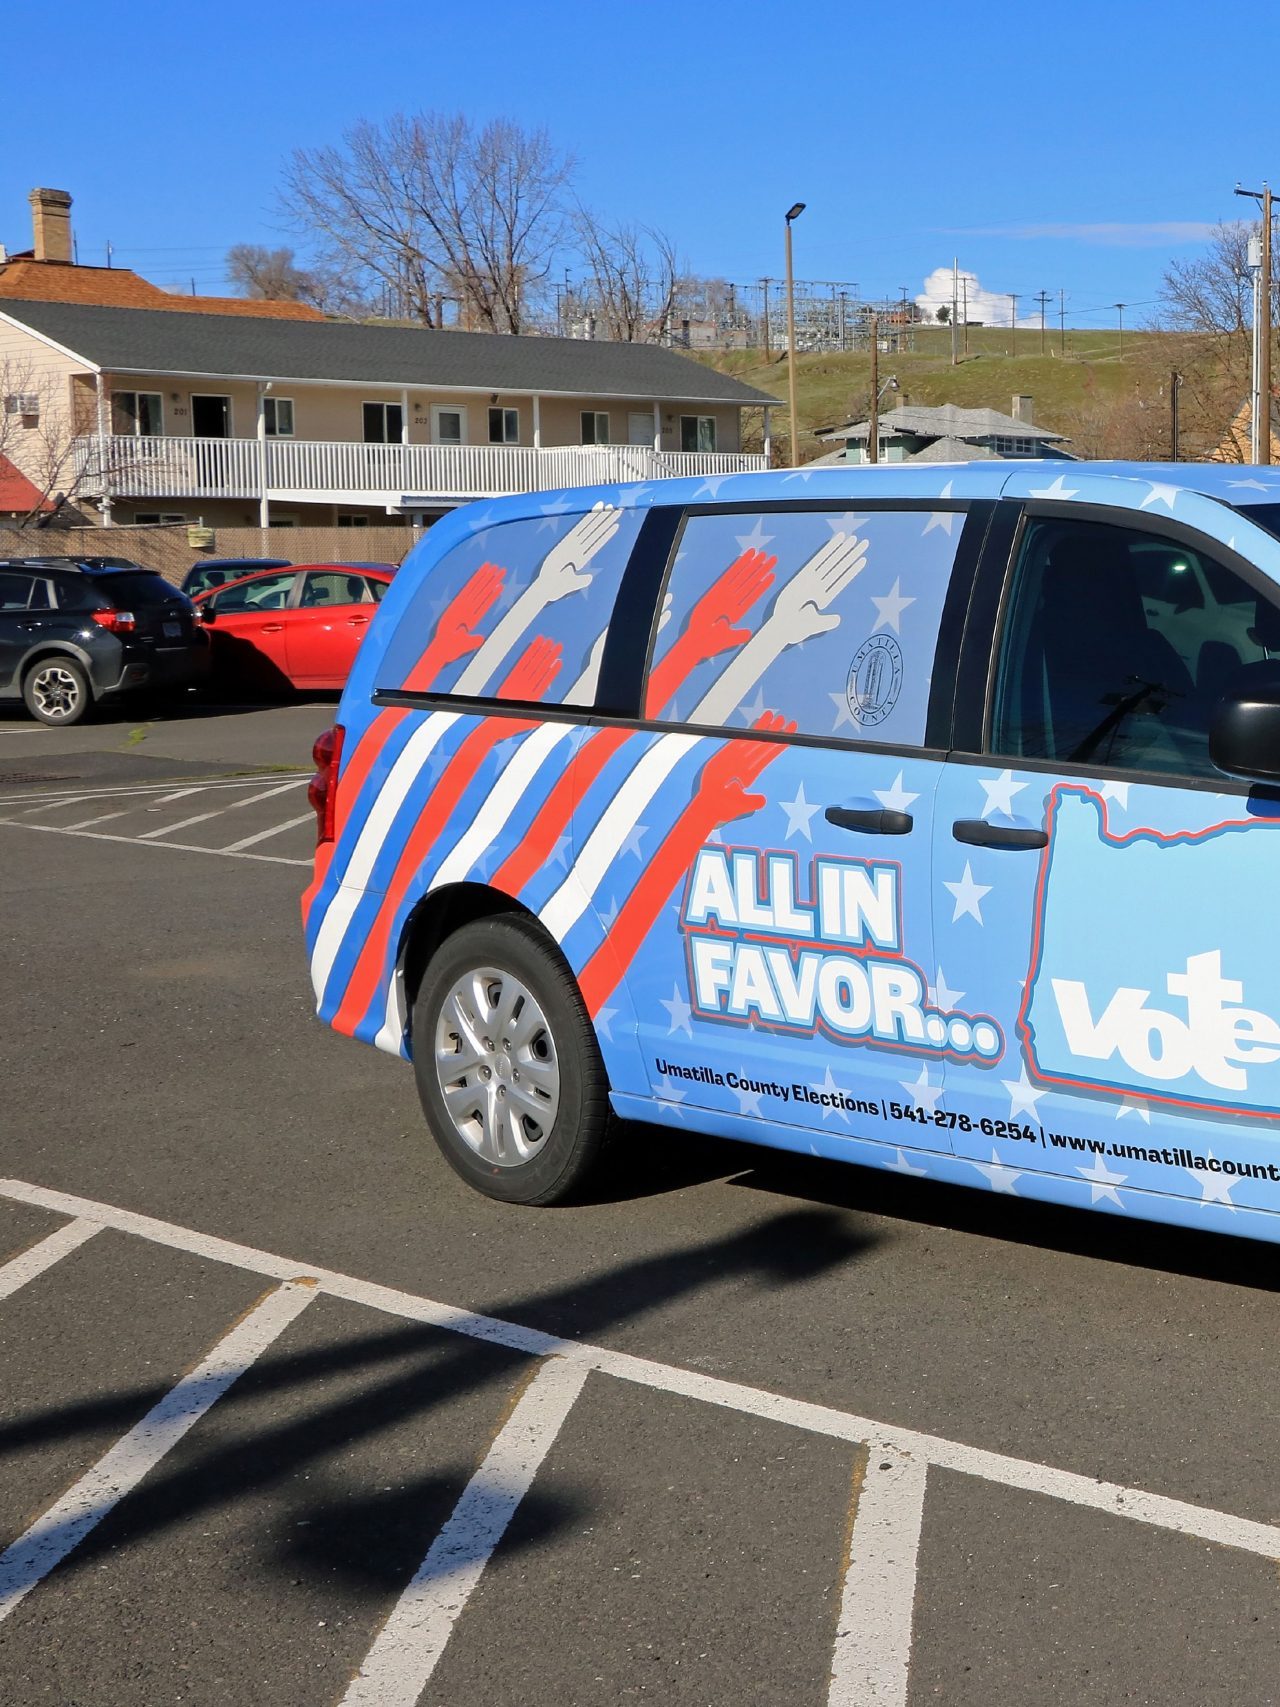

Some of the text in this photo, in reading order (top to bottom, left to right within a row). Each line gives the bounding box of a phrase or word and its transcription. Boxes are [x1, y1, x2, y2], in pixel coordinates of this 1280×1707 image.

[686, 849, 899, 949] ALL IN
[655, 1058, 726, 1087] Umatilla
[727, 1072, 790, 1102] County
[793, 1085, 880, 1115] Elections
[889, 1102, 1037, 1143] 541-278-6254
